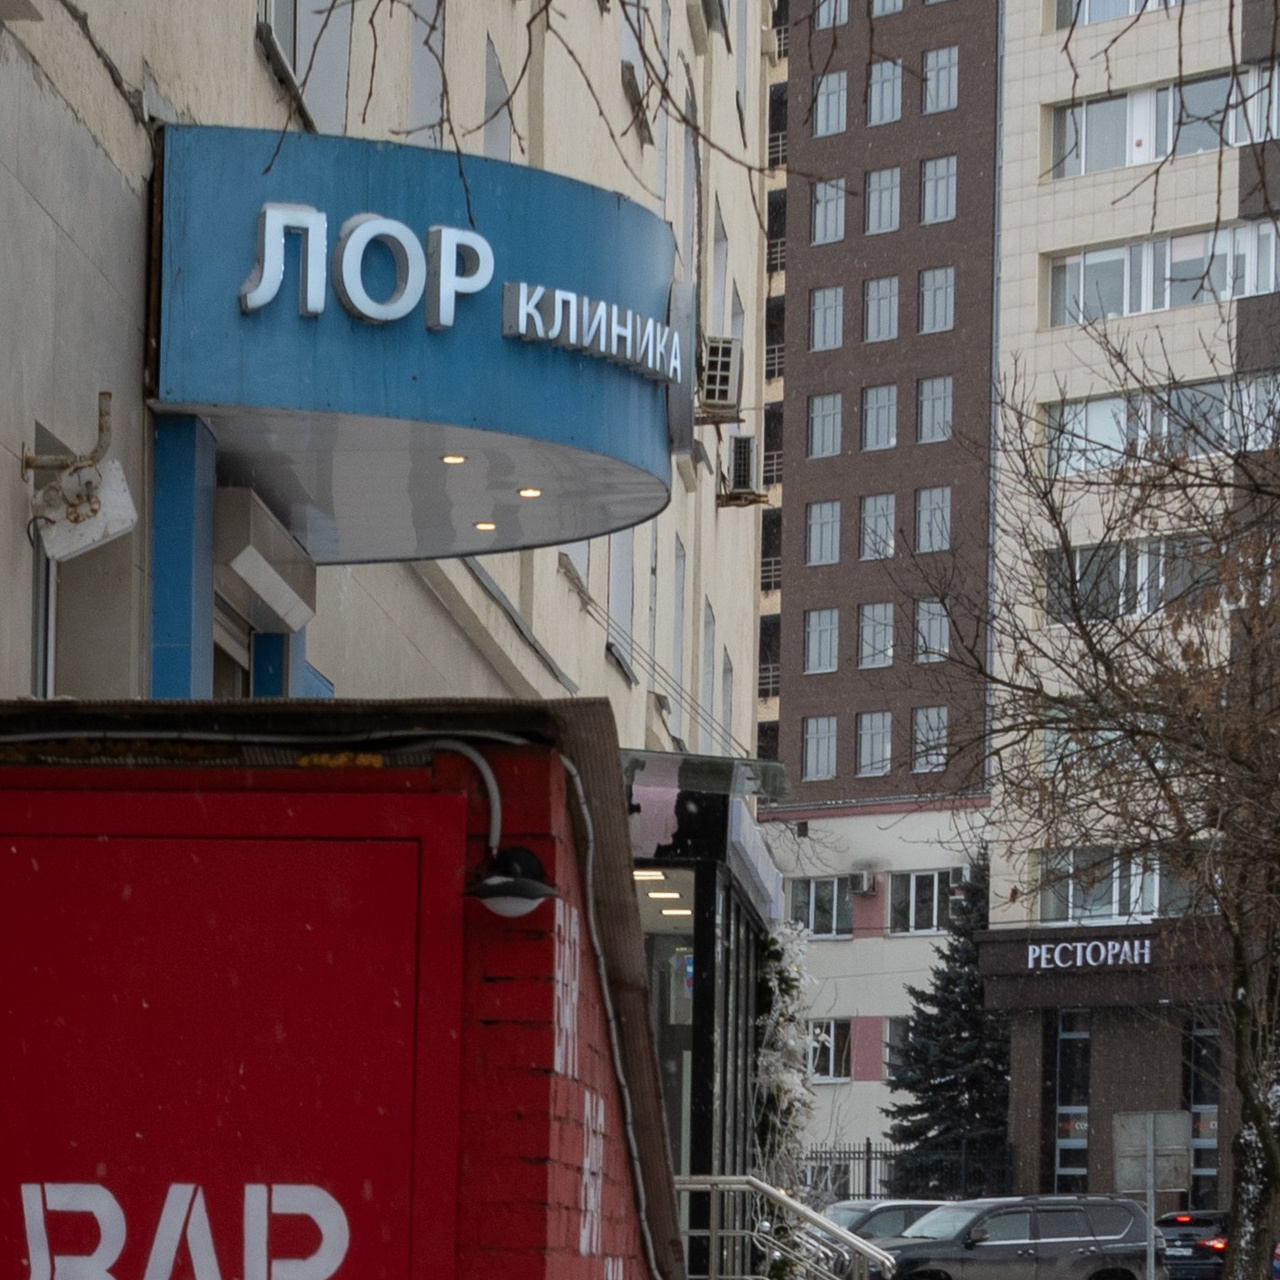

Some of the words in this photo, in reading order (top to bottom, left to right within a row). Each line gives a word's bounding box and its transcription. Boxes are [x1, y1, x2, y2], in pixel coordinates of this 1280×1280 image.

[239, 206, 496, 331] ЛОР
[516, 282, 683, 385] КЛИНИКА
[1027, 939, 1151, 969] РЕСТОРАН
